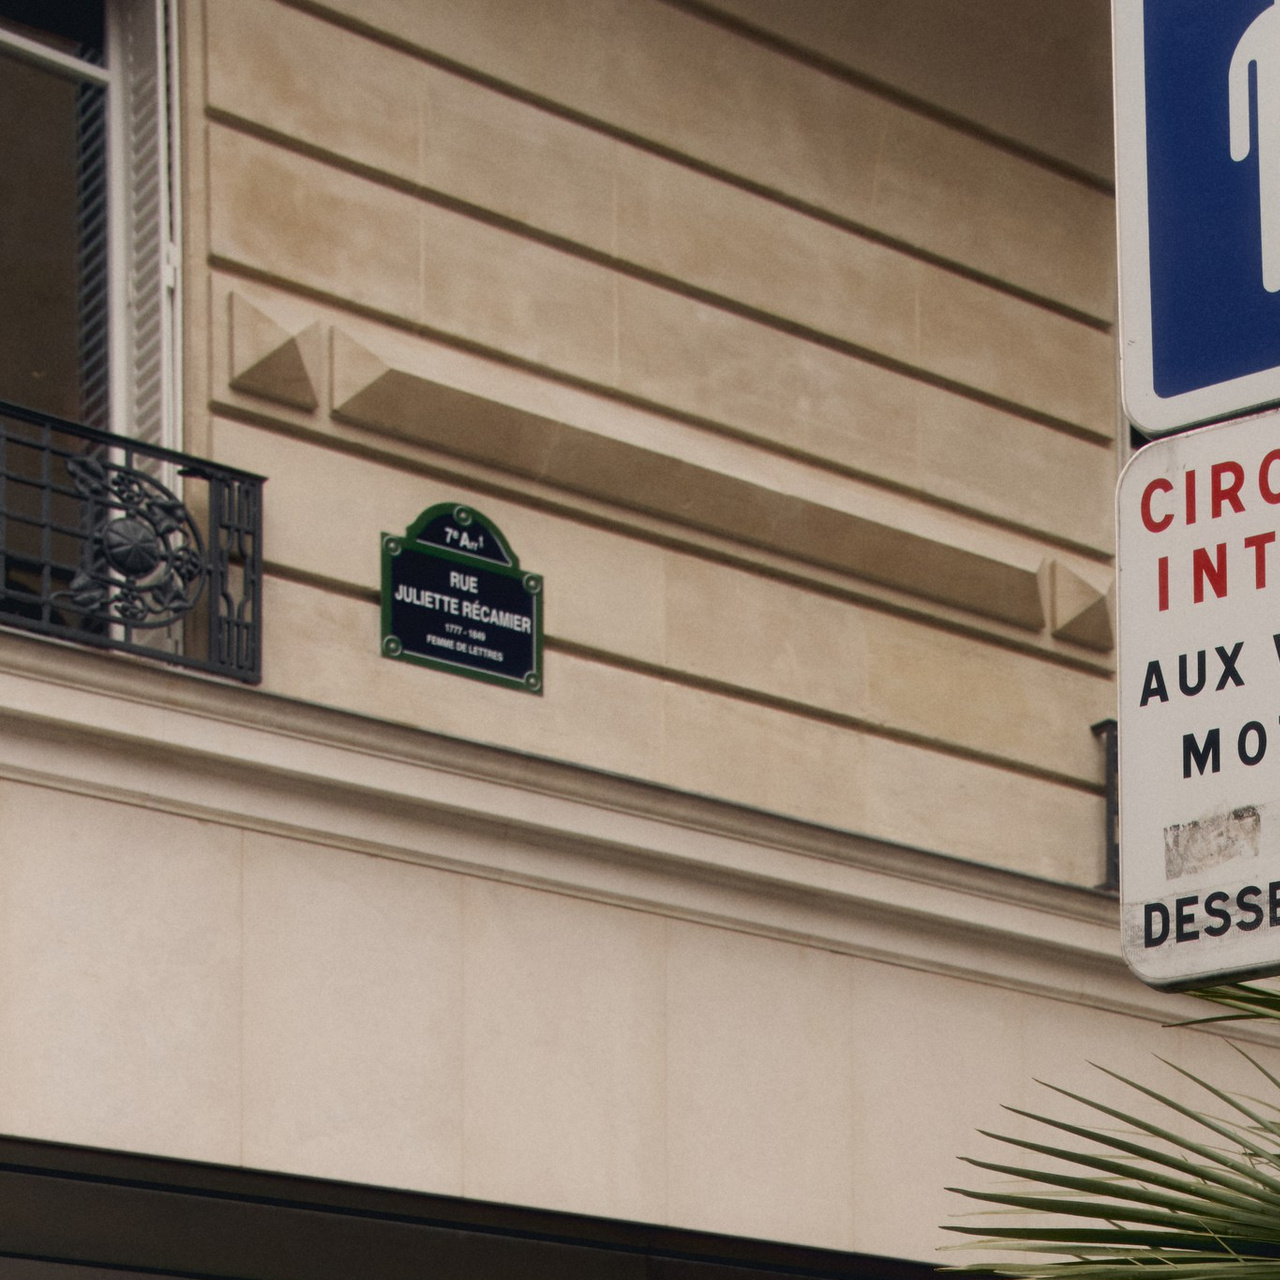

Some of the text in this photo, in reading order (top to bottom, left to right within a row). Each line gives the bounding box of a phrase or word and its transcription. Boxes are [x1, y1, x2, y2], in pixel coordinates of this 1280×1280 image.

[450, 571, 479, 594] RUE
[394, 584, 532, 634] JULIETTE RÉCAMIER
[445, 622, 463, 635] 1777
[426, 633, 504, 662] FEMME DE LETTRES
[1139, 641, 1245, 708] AUX
